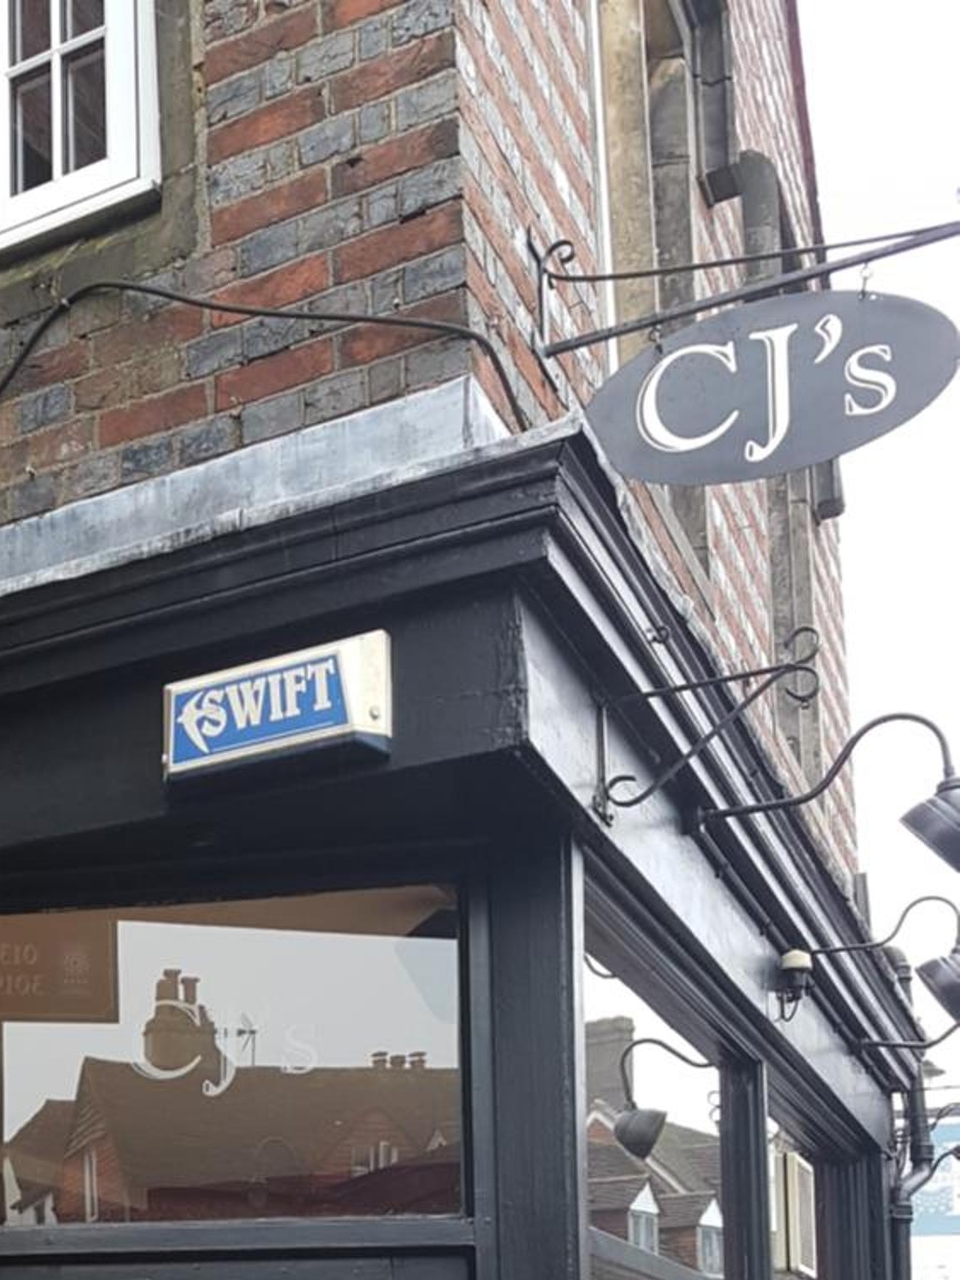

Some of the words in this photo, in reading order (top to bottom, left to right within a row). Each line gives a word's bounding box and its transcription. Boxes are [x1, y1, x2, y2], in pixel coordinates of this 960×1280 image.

[636, 314, 897, 462] CJ's
[200, 658, 336, 738] SWIFT
[131, 1000, 320, 1097] CJs
